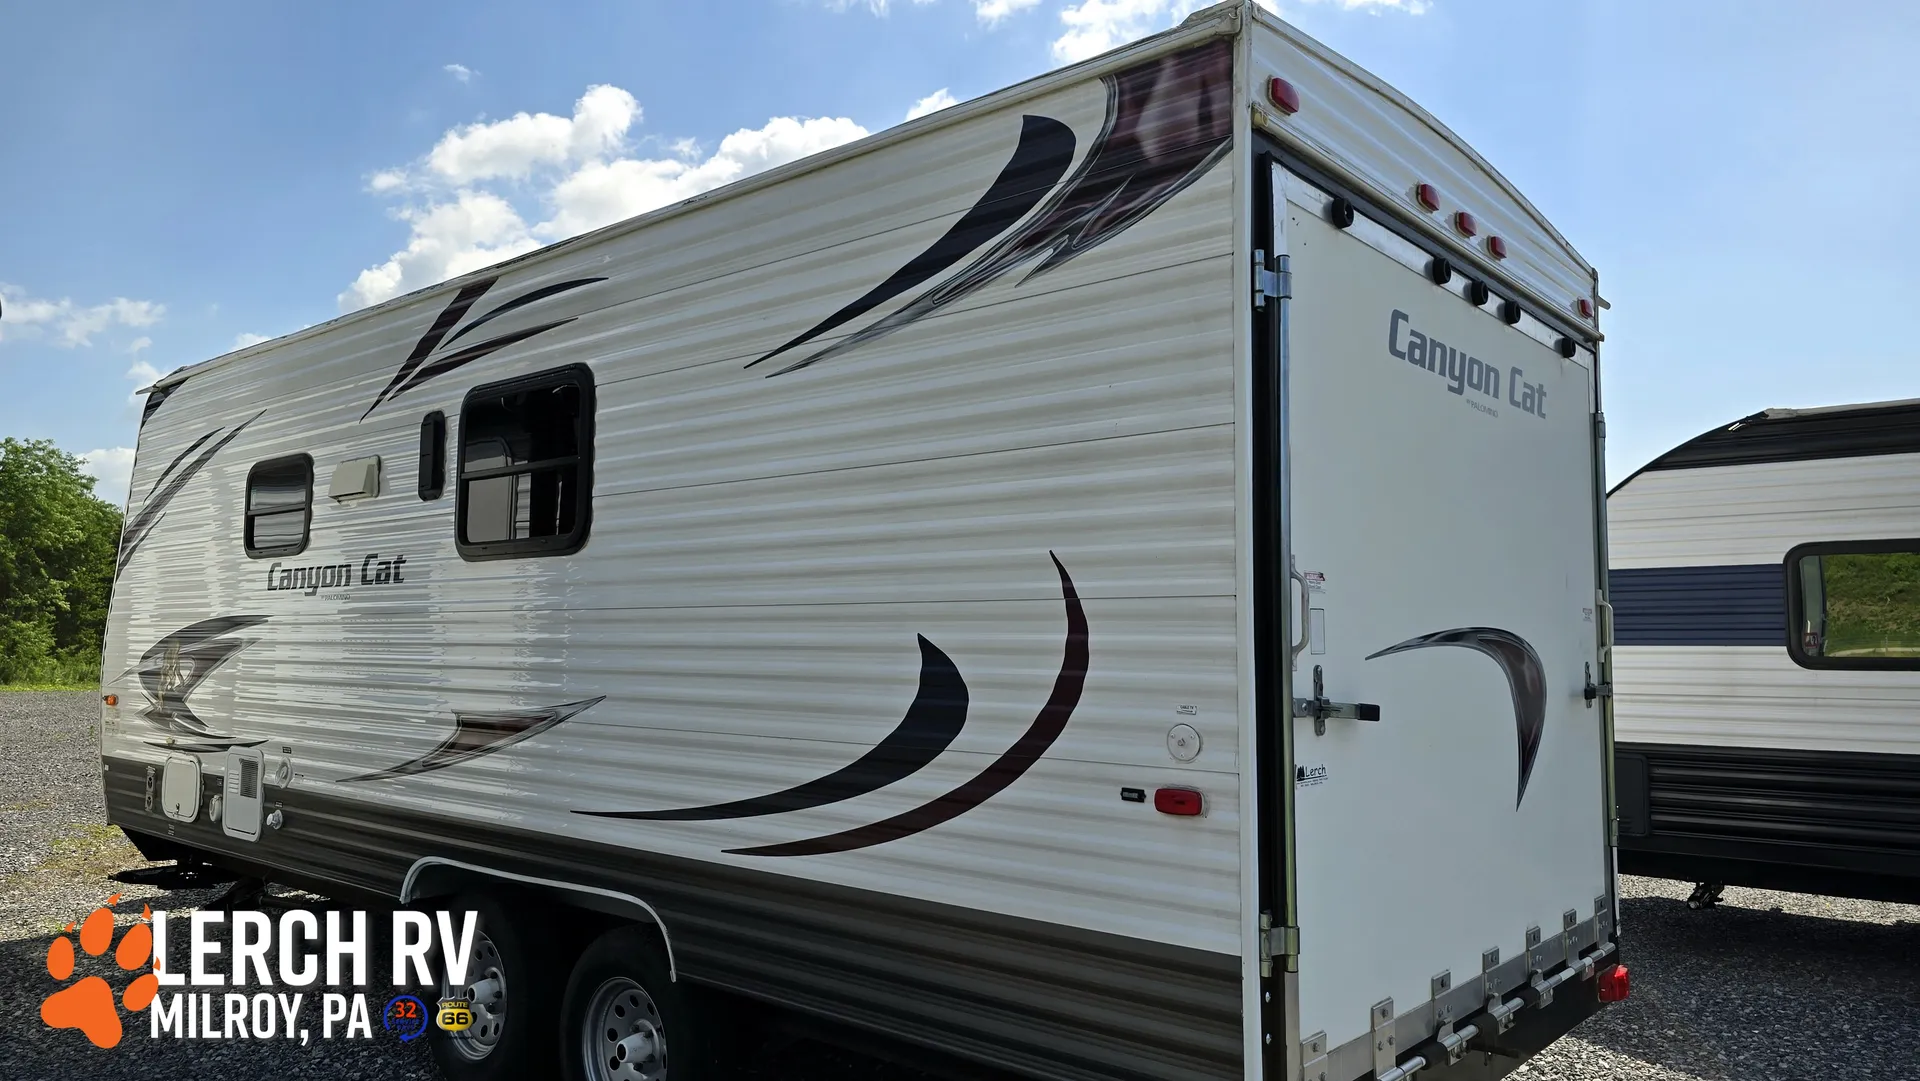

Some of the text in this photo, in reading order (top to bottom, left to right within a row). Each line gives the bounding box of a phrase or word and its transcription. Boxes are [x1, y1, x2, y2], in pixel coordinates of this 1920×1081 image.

[1388, 308, 1547, 420] Canyon Cat
[267, 553, 407, 597] Canyon Cat
[1305, 763, 1327, 778] Lerch
